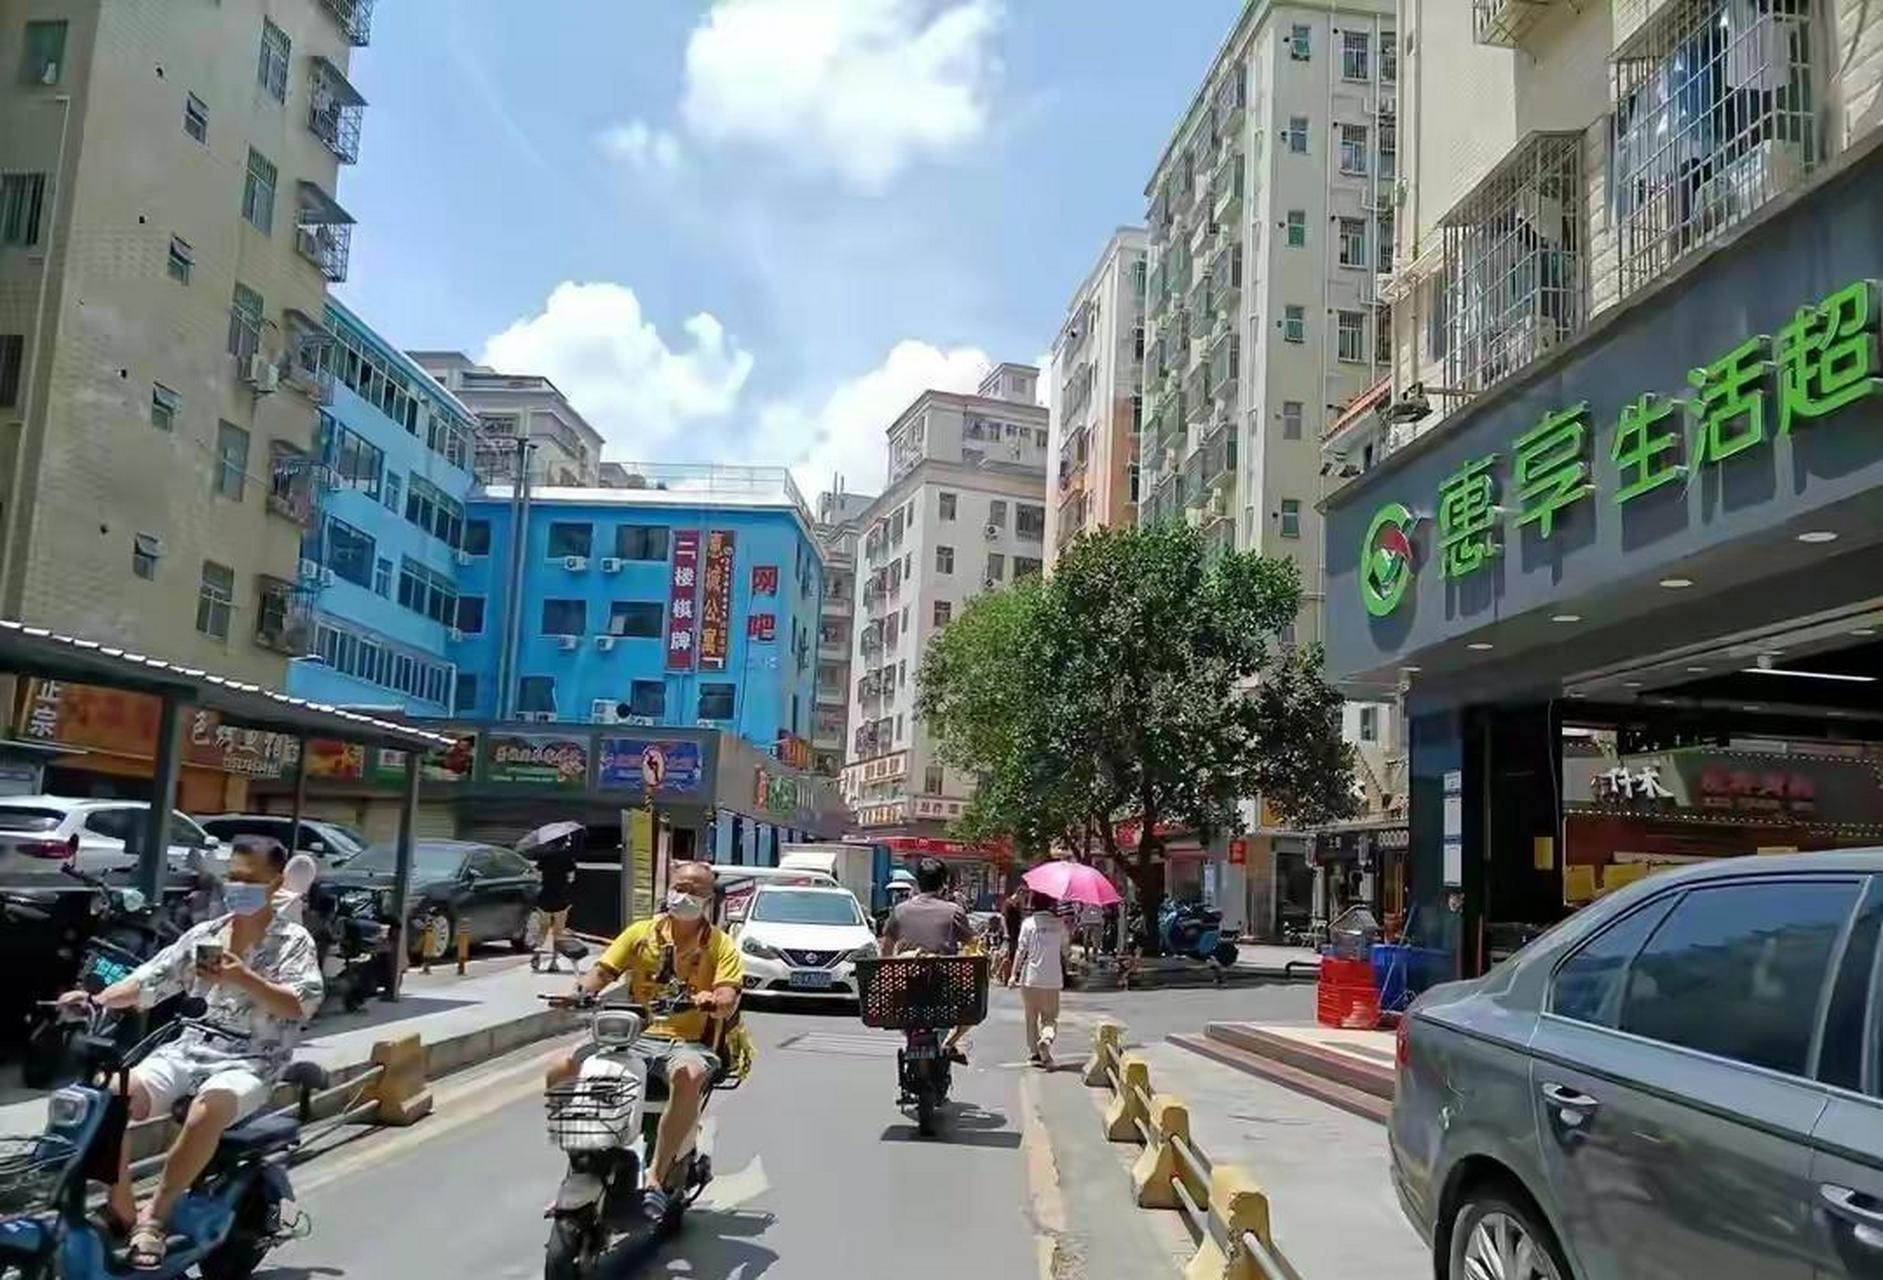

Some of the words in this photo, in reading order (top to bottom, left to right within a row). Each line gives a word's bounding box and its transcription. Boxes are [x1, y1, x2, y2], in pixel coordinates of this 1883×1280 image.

[1437, 279, 1880, 580] 惠享生活超
[670, 541, 697, 650] 二楼棋牌
